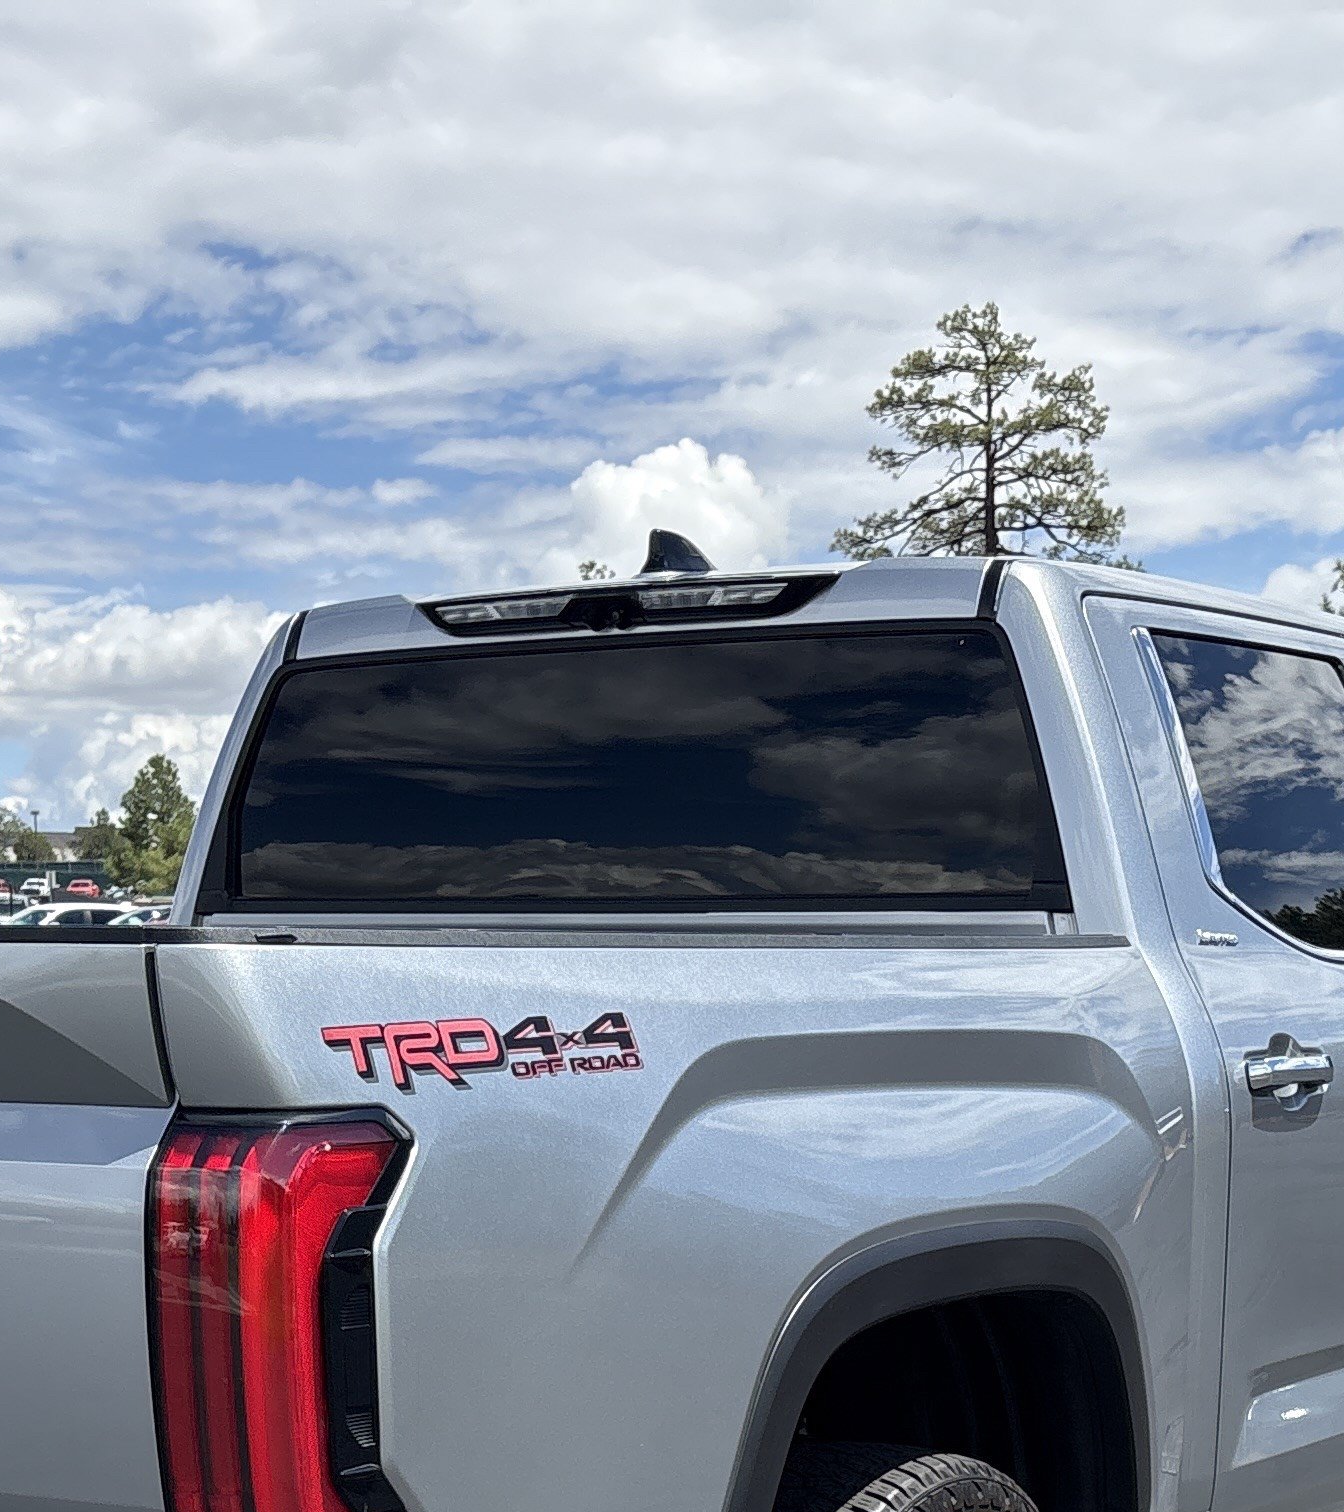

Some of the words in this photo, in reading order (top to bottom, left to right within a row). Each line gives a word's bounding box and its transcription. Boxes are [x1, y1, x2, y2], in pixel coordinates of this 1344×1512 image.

[320, 1017, 508, 1095] TRD
[503, 1011, 640, 1059] 4x4
[511, 1056, 567, 1080] OFF
[569, 1052, 644, 1077] ROAD
